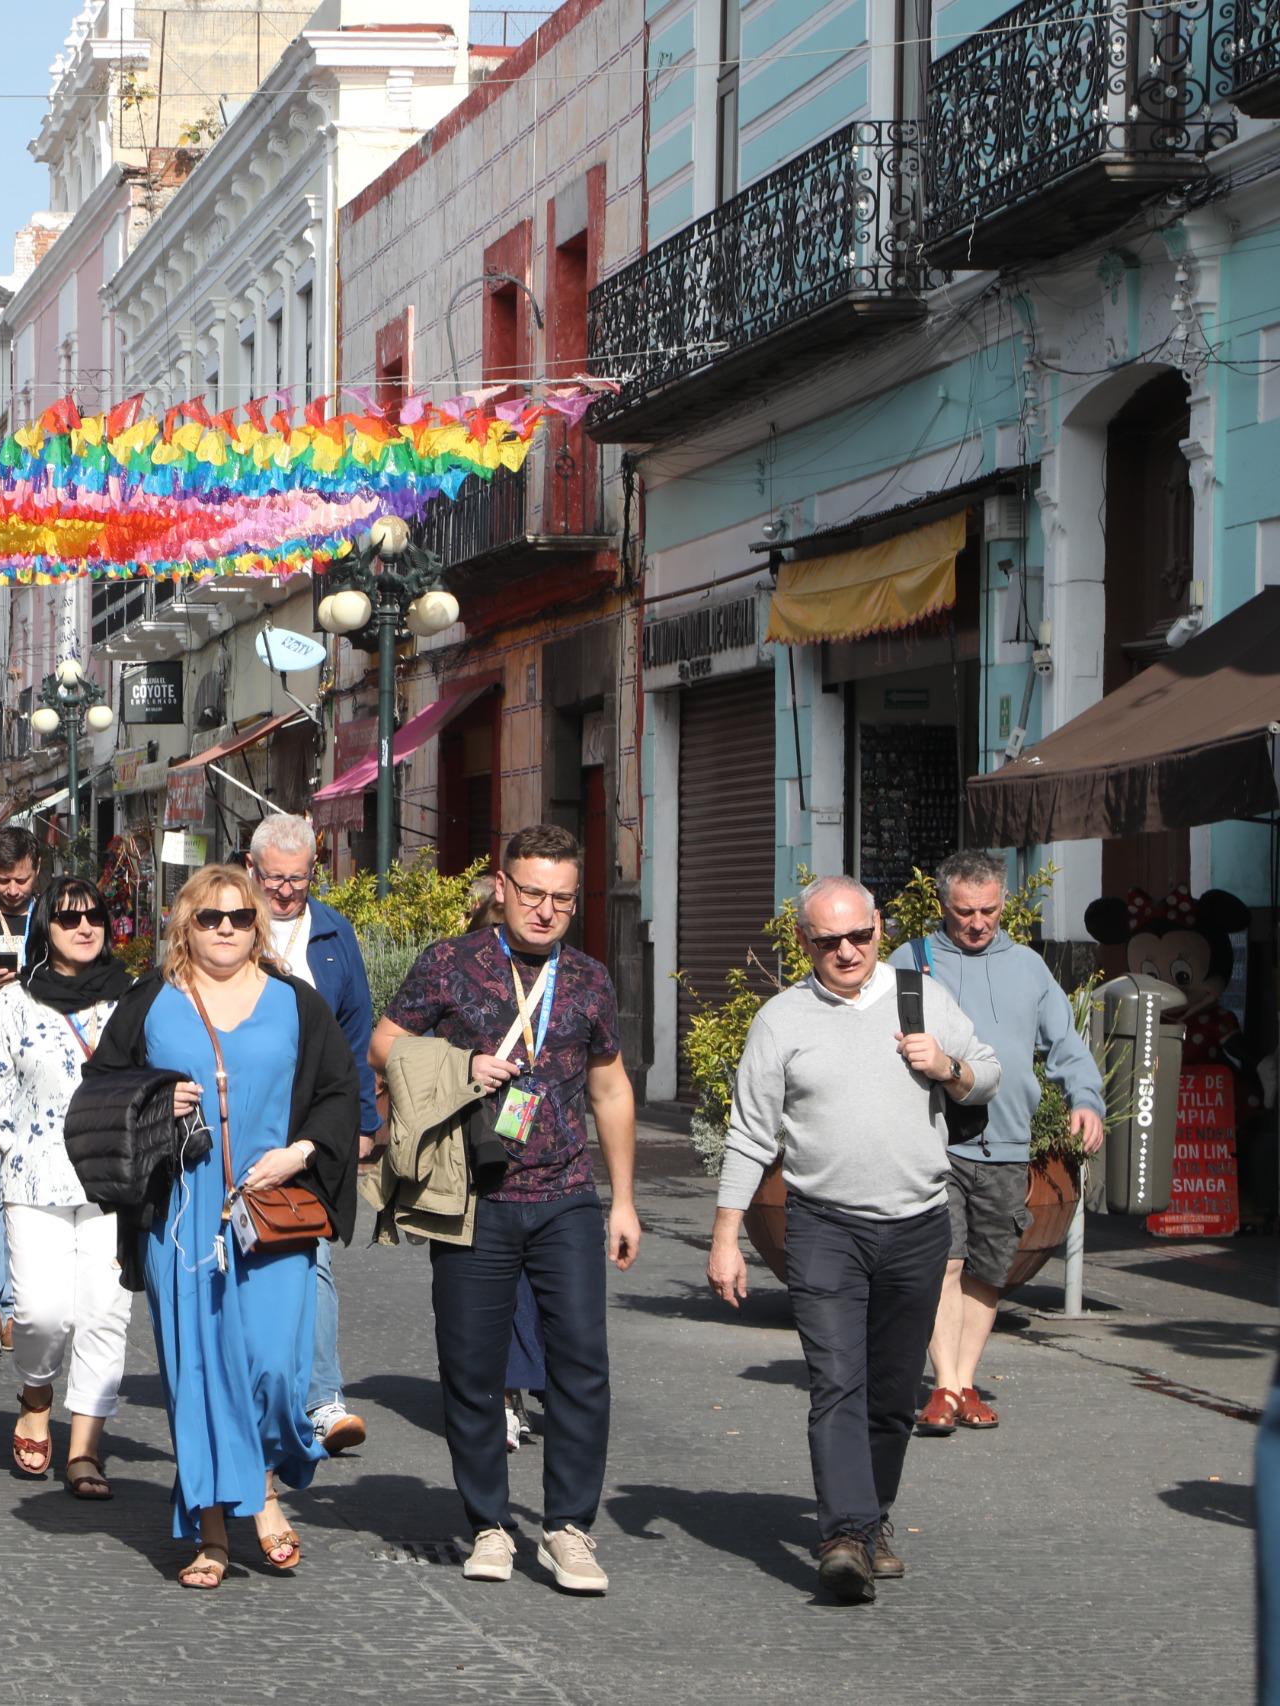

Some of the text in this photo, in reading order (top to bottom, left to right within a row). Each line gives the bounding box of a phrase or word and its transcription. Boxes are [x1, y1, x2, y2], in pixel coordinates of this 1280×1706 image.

[132, 684, 175, 699] COYOTE
[1178, 1075, 1224, 1089] EZ DE
[1177, 1092, 1224, 1107] TILLA
[1176, 1109, 1216, 1124] MPIA
[1173, 1144, 1200, 1159] ION
[1172, 1178, 1226, 1193] SNAGA
